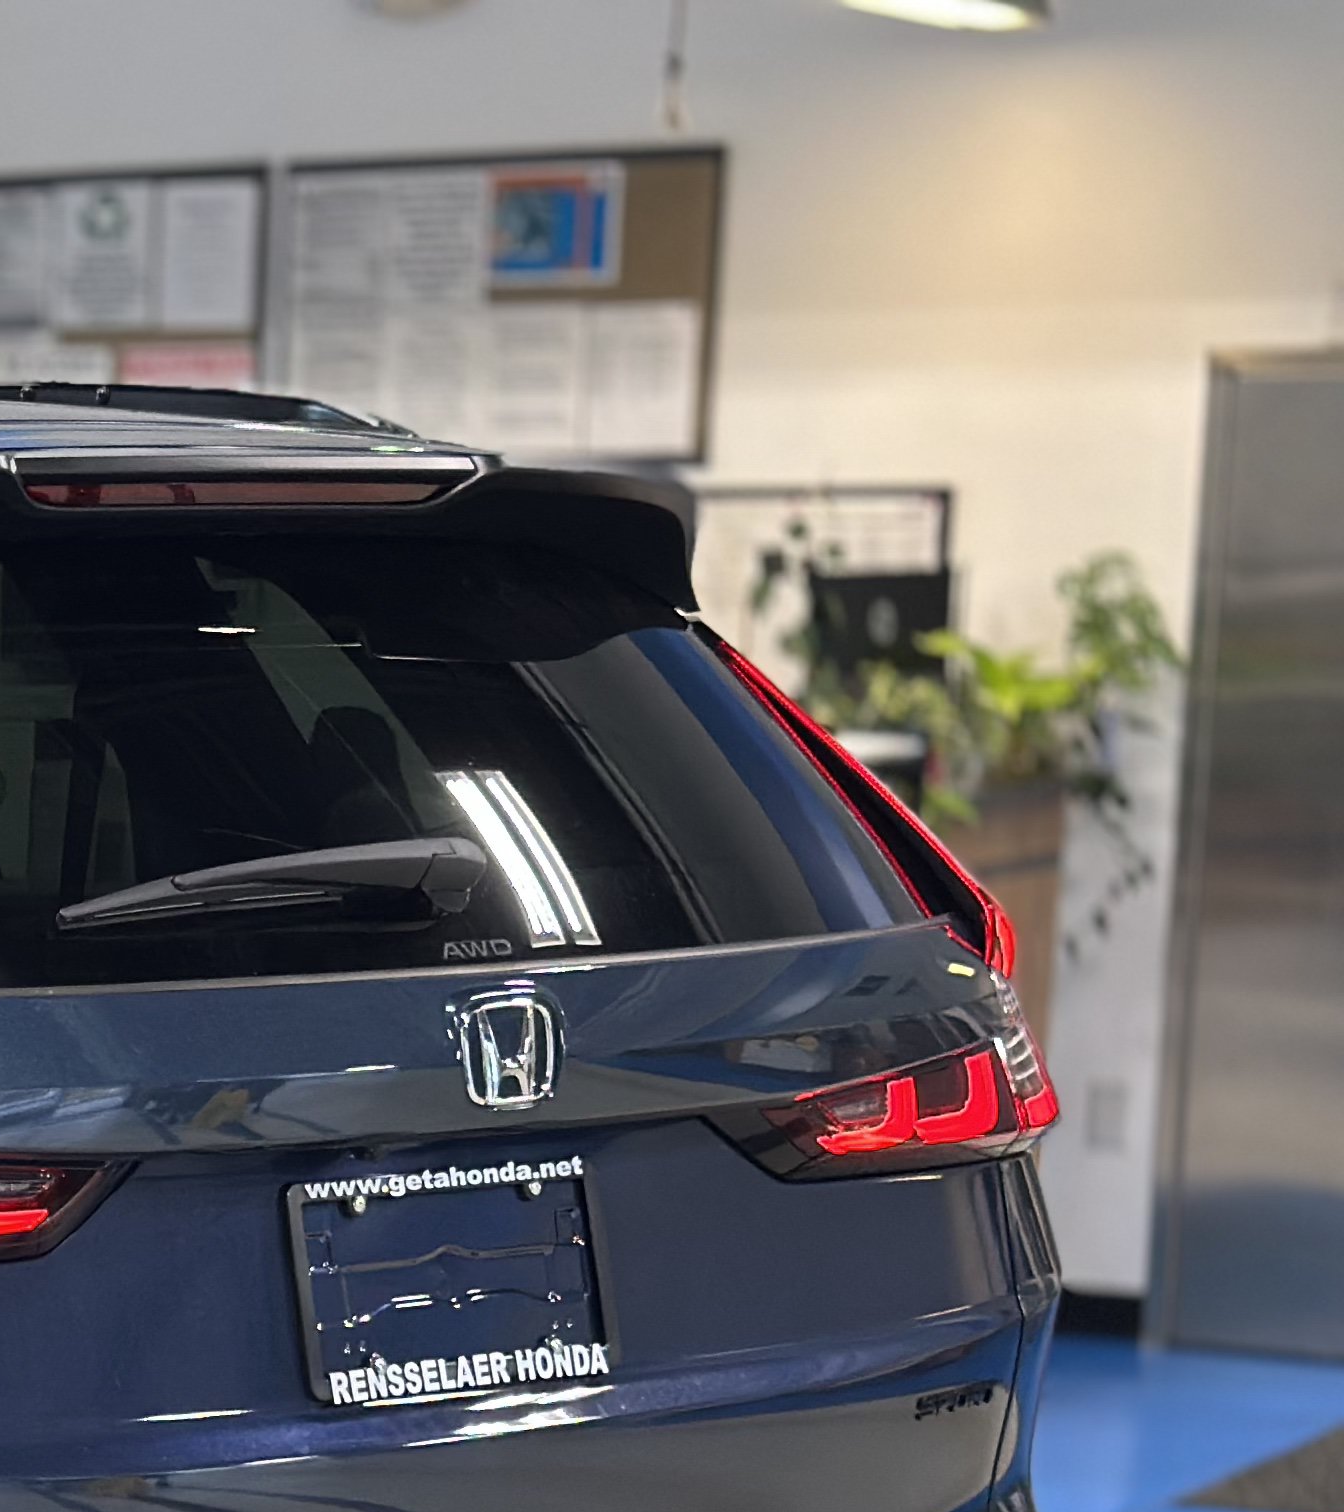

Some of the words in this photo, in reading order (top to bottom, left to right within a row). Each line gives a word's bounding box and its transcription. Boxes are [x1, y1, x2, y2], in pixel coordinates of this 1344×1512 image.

[443, 938, 512, 960] AWD
[304, 1156, 584, 1199] www.getahonda.net
[328, 1351, 511, 1404] RENSSELAER
[514, 1343, 610, 1383] HONDA
